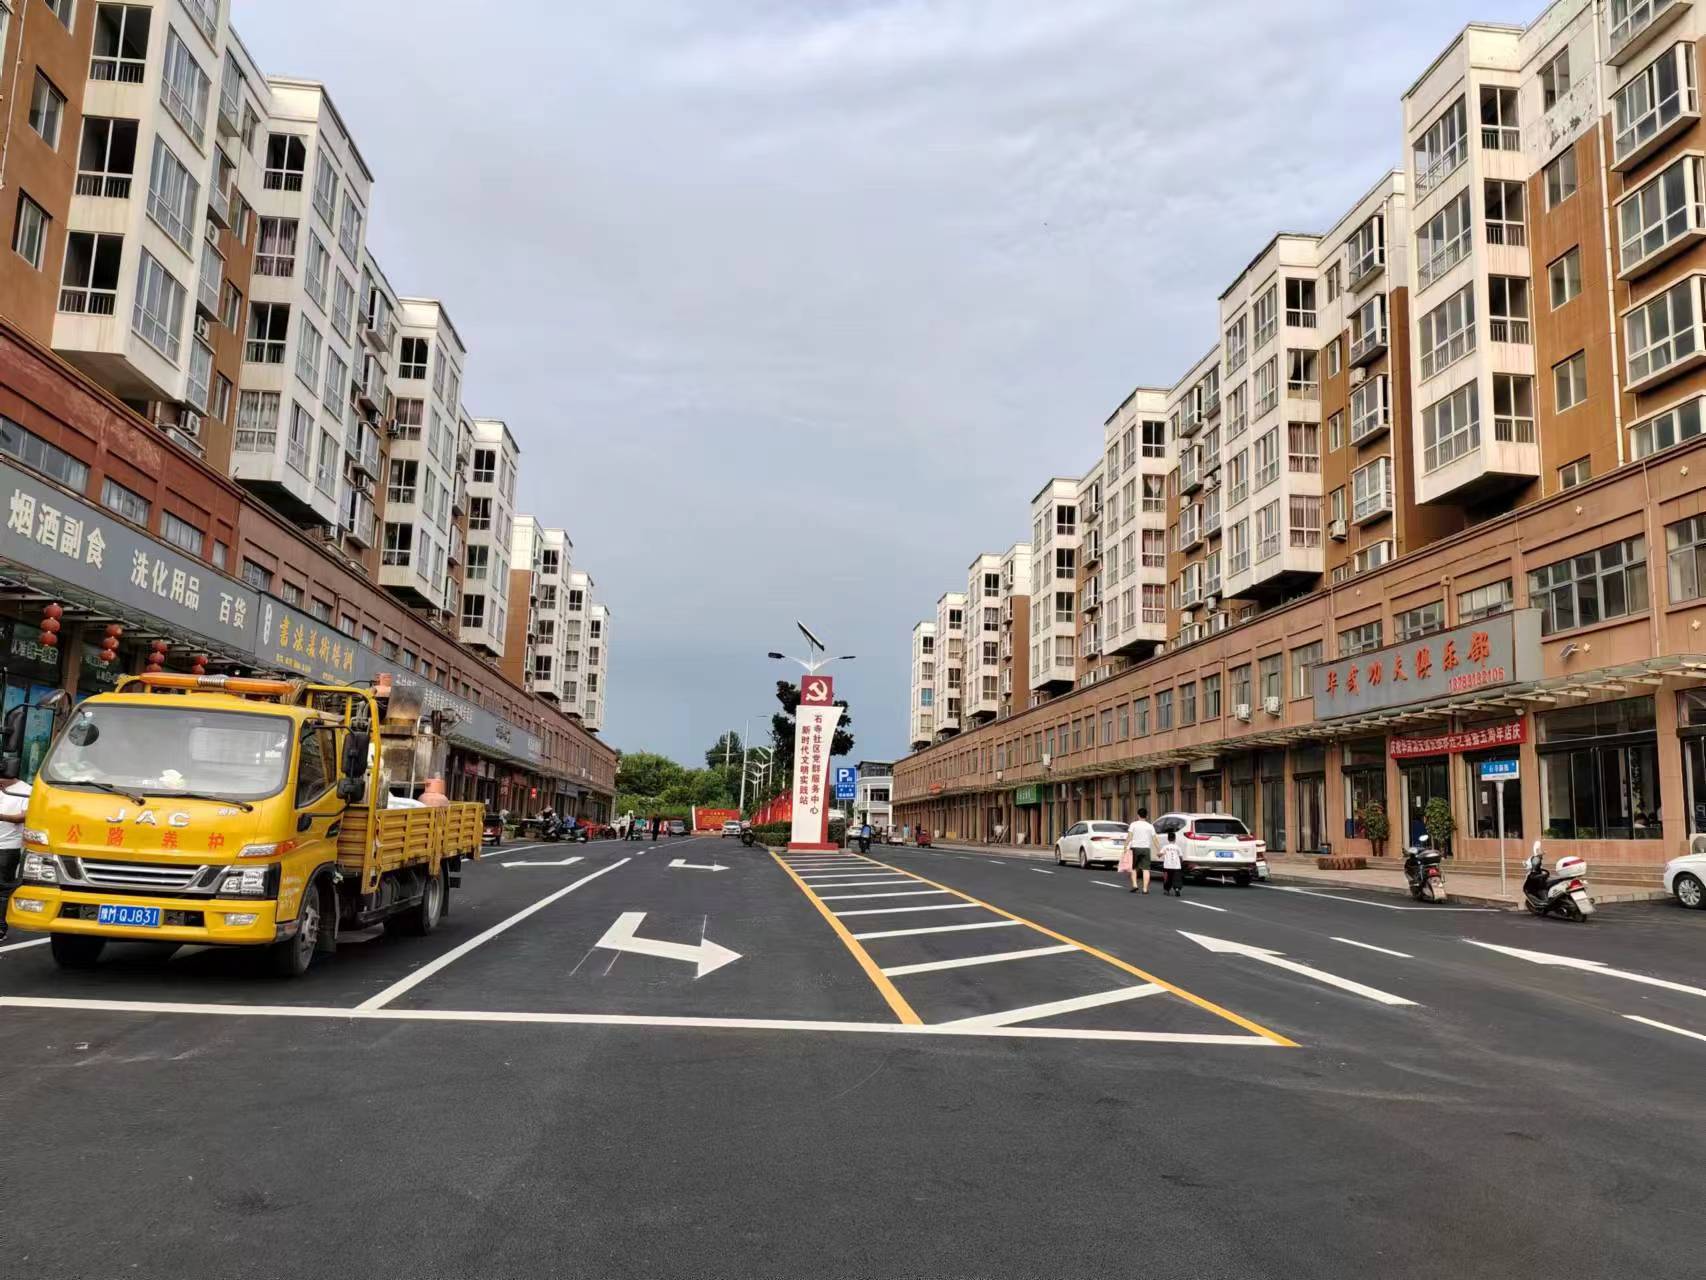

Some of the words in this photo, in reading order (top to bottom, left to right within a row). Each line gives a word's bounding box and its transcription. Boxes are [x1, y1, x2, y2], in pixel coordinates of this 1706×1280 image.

[7, 487, 107, 570] 烟酒副食
[129, 548, 200, 612] 洗化用品
[217, 591, 247, 631] 百货
[799, 725, 811, 806] 新时代文明实践站
[809, 714, 823, 815] 石寺社区党群服务中心
[839, 769, 850, 782] P
[66, 824, 225, 850] 公路养护
[105, 808, 191, 828] JAC
